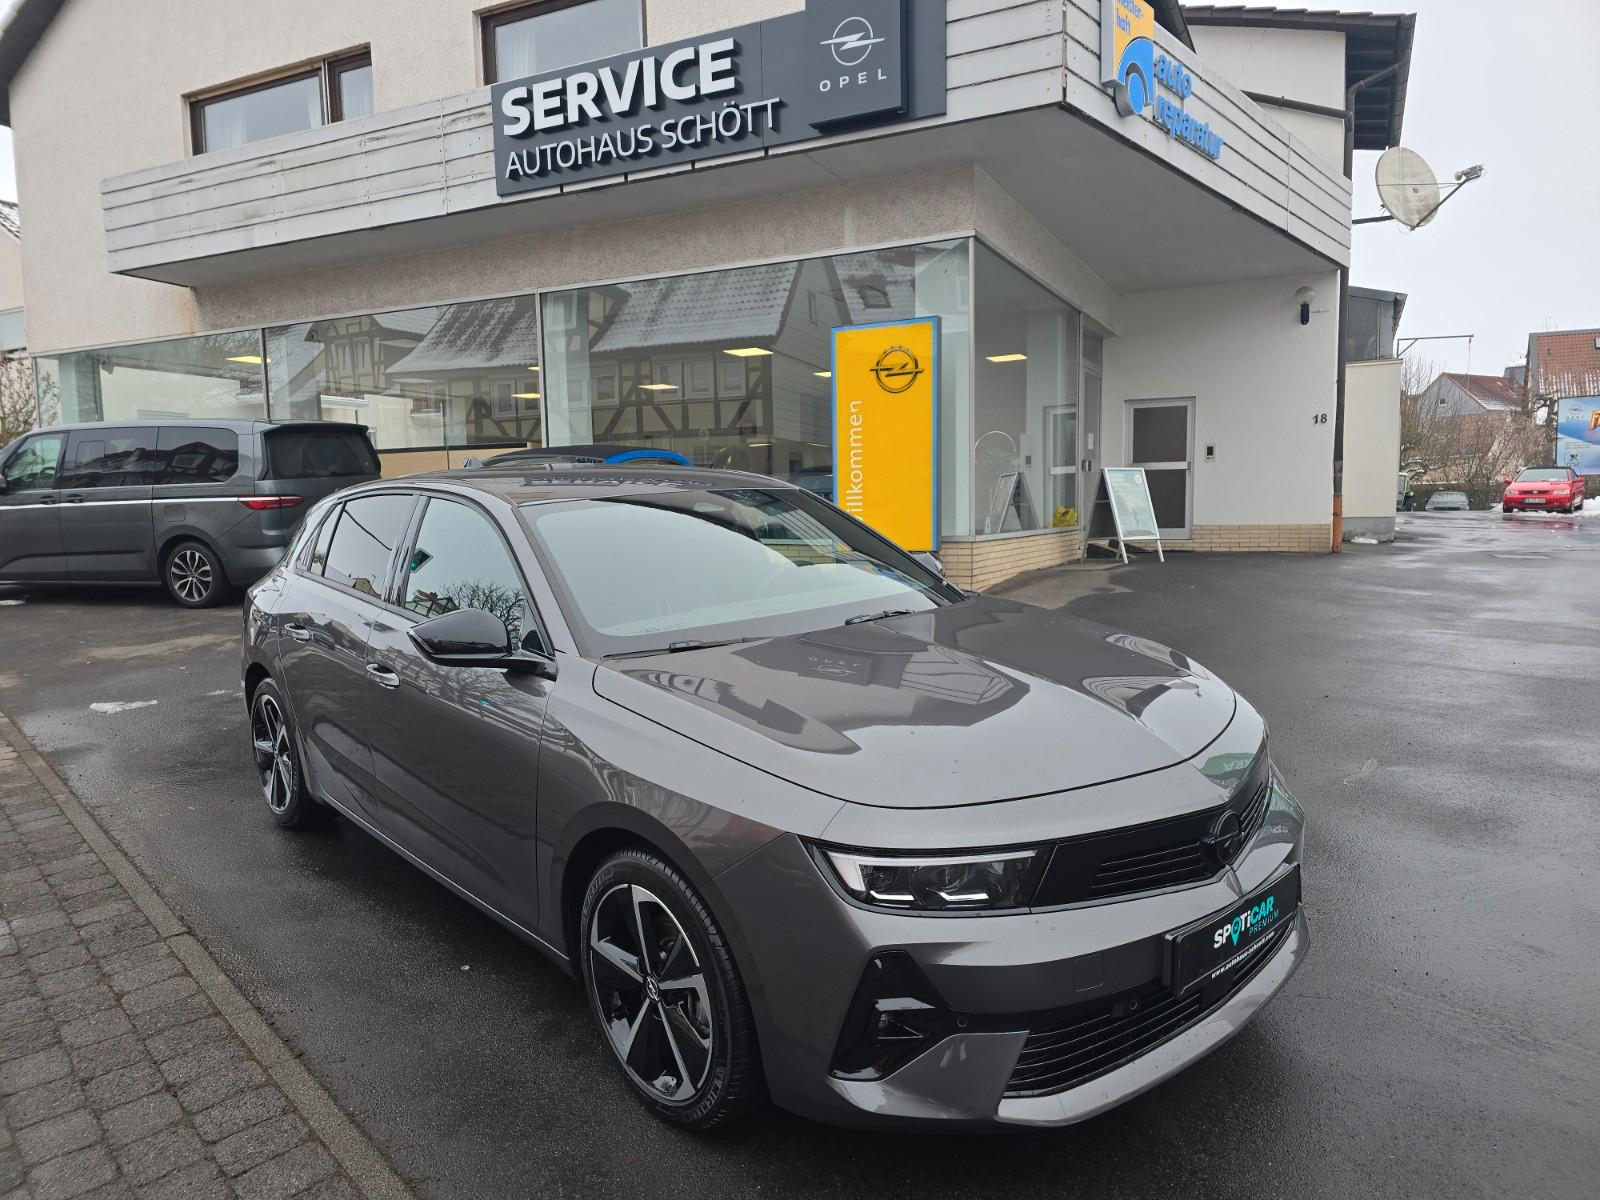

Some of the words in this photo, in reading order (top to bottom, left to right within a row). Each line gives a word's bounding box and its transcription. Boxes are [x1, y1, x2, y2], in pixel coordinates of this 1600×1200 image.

[501, 37, 737, 137] SERVICE
[819, 68, 887, 92] OPEL
[1157, 54, 1192, 99] auto
[505, 123, 653, 179] AUTOHAUS
[665, 97, 780, 144] SCHÖTT
[1156, 95, 1223, 159] reparatur
[1312, 413, 1328, 424] 18
[1249, 908, 1279, 936] PREMIUM
